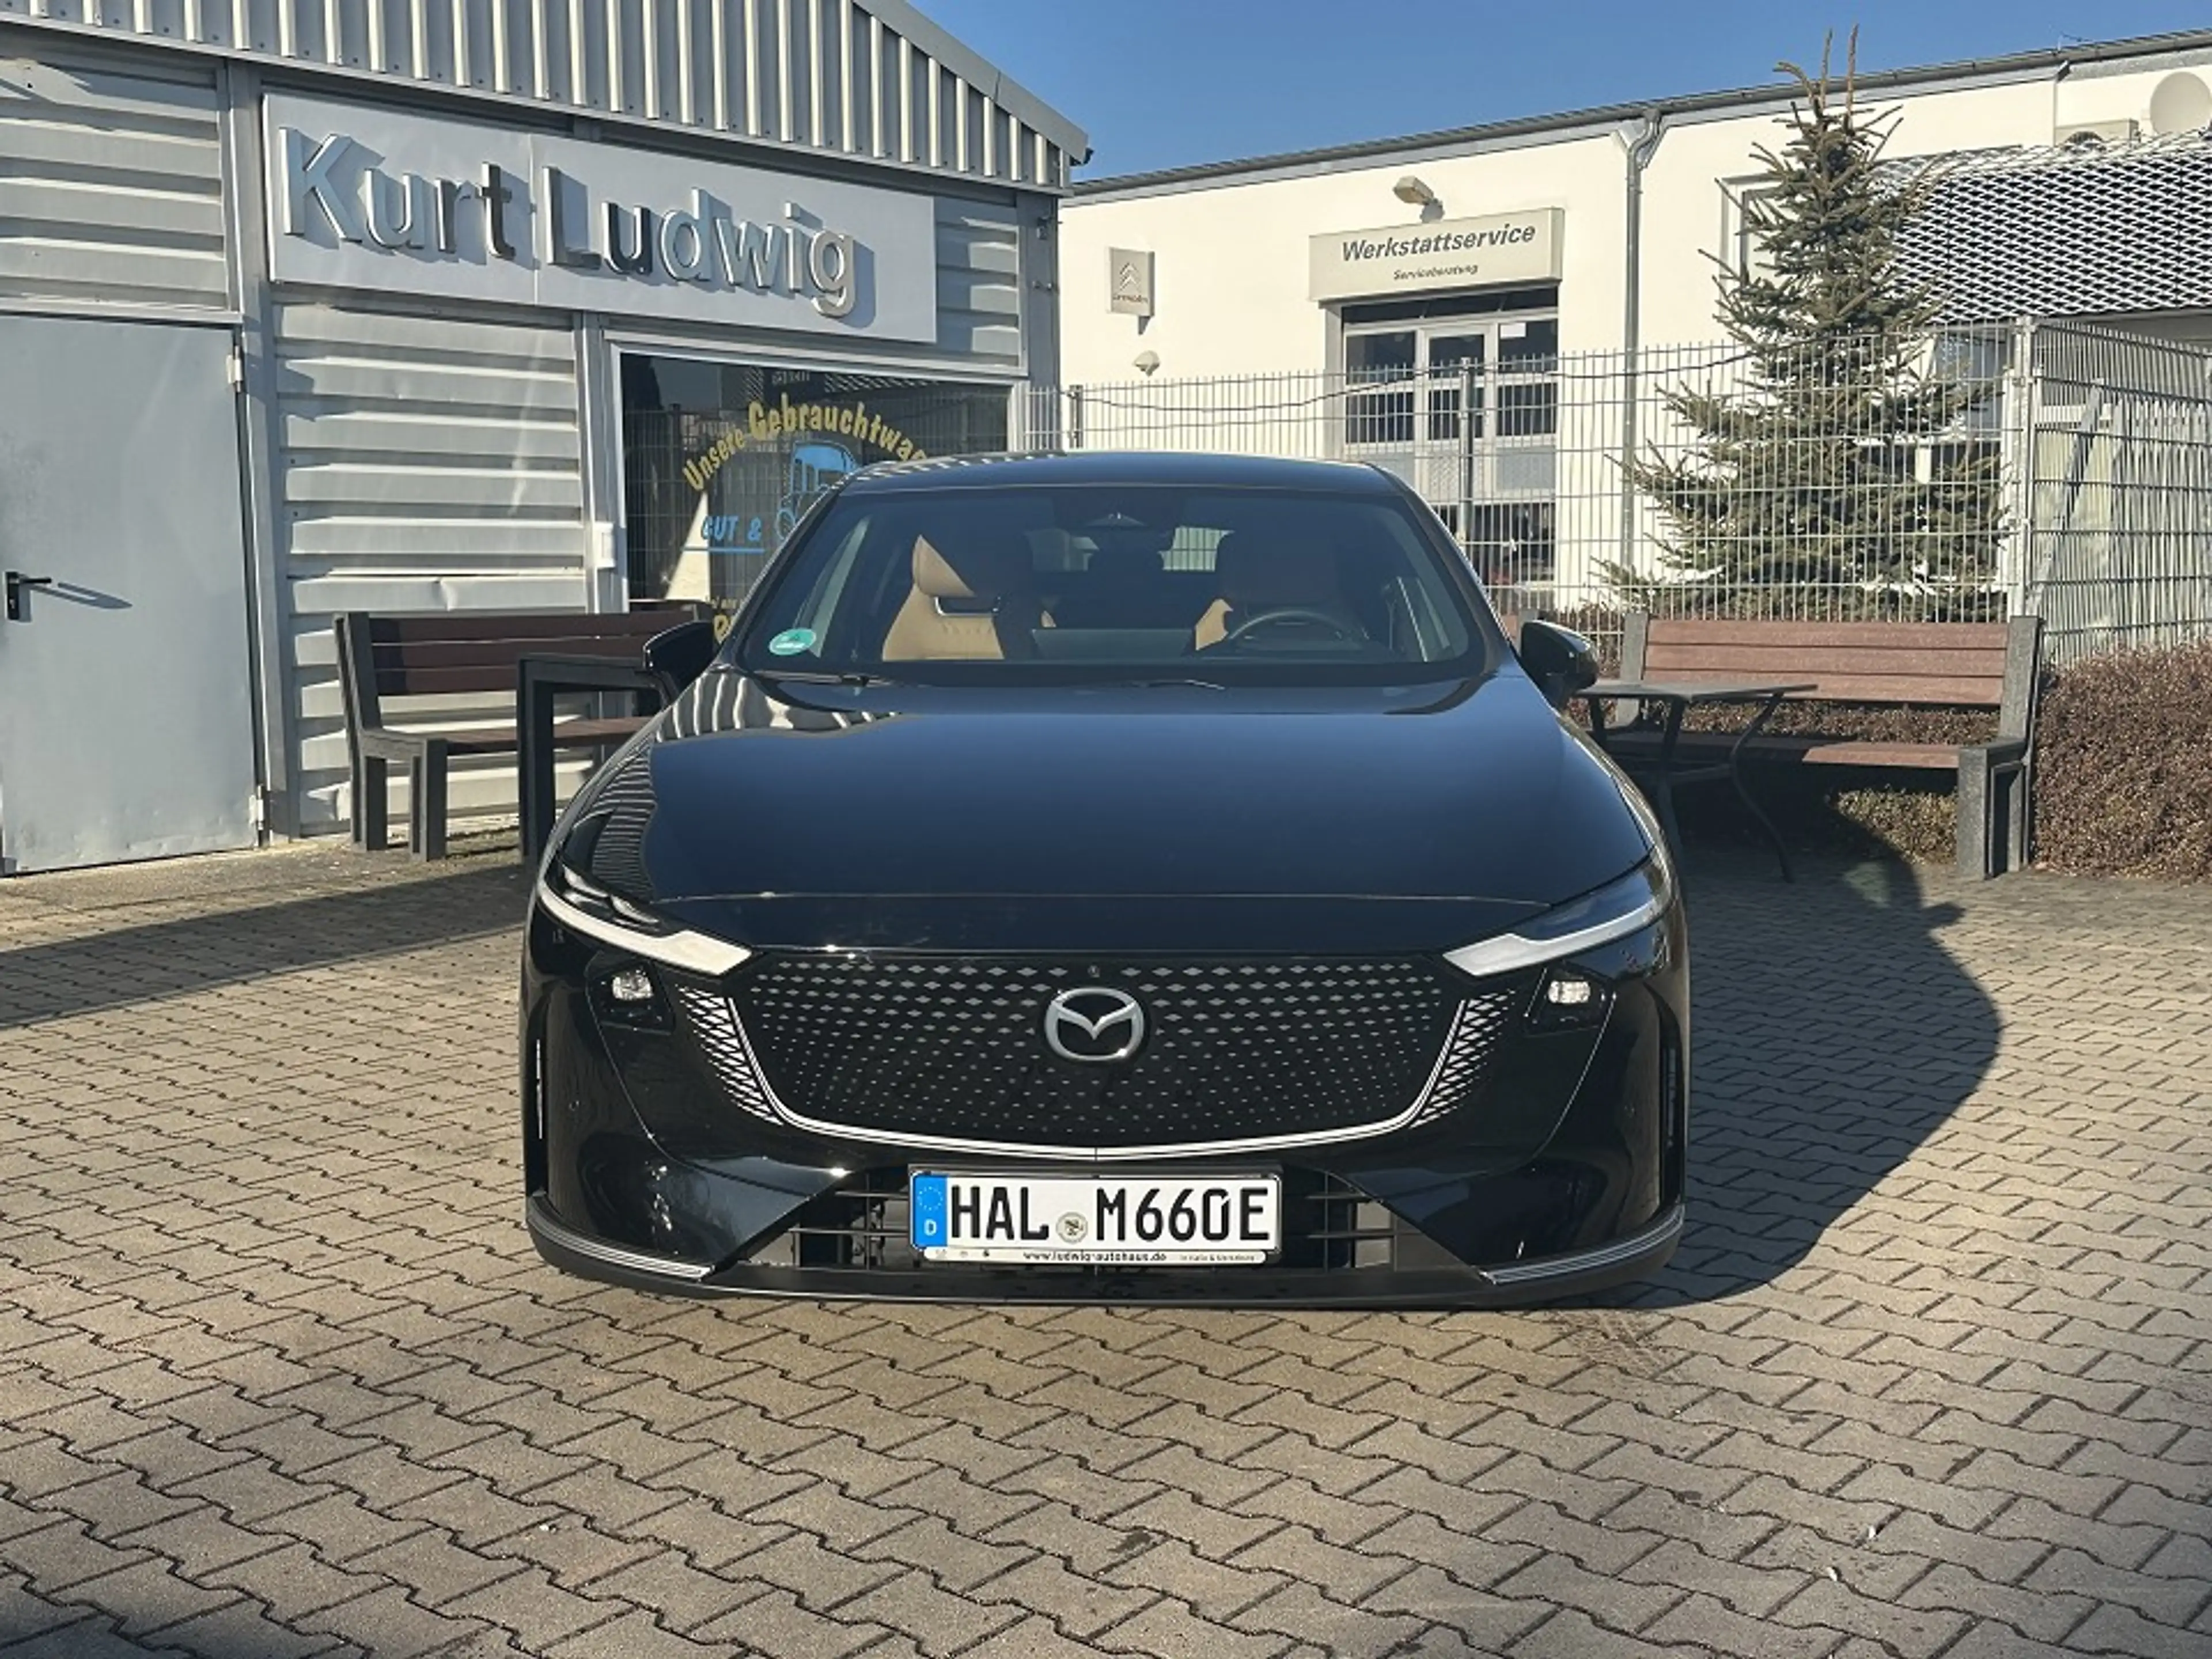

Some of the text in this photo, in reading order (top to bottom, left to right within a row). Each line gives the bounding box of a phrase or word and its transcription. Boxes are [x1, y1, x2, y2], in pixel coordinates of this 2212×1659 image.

[278, 127, 856, 316] Kurt Ludwig
[1342, 223, 1536, 262] Werkstattservice
[682, 427, 745, 491] Unsere
[700, 515, 762, 542] GUT &
[924, 1218, 937, 1236] D
[951, 1184, 1050, 1241] HAL
